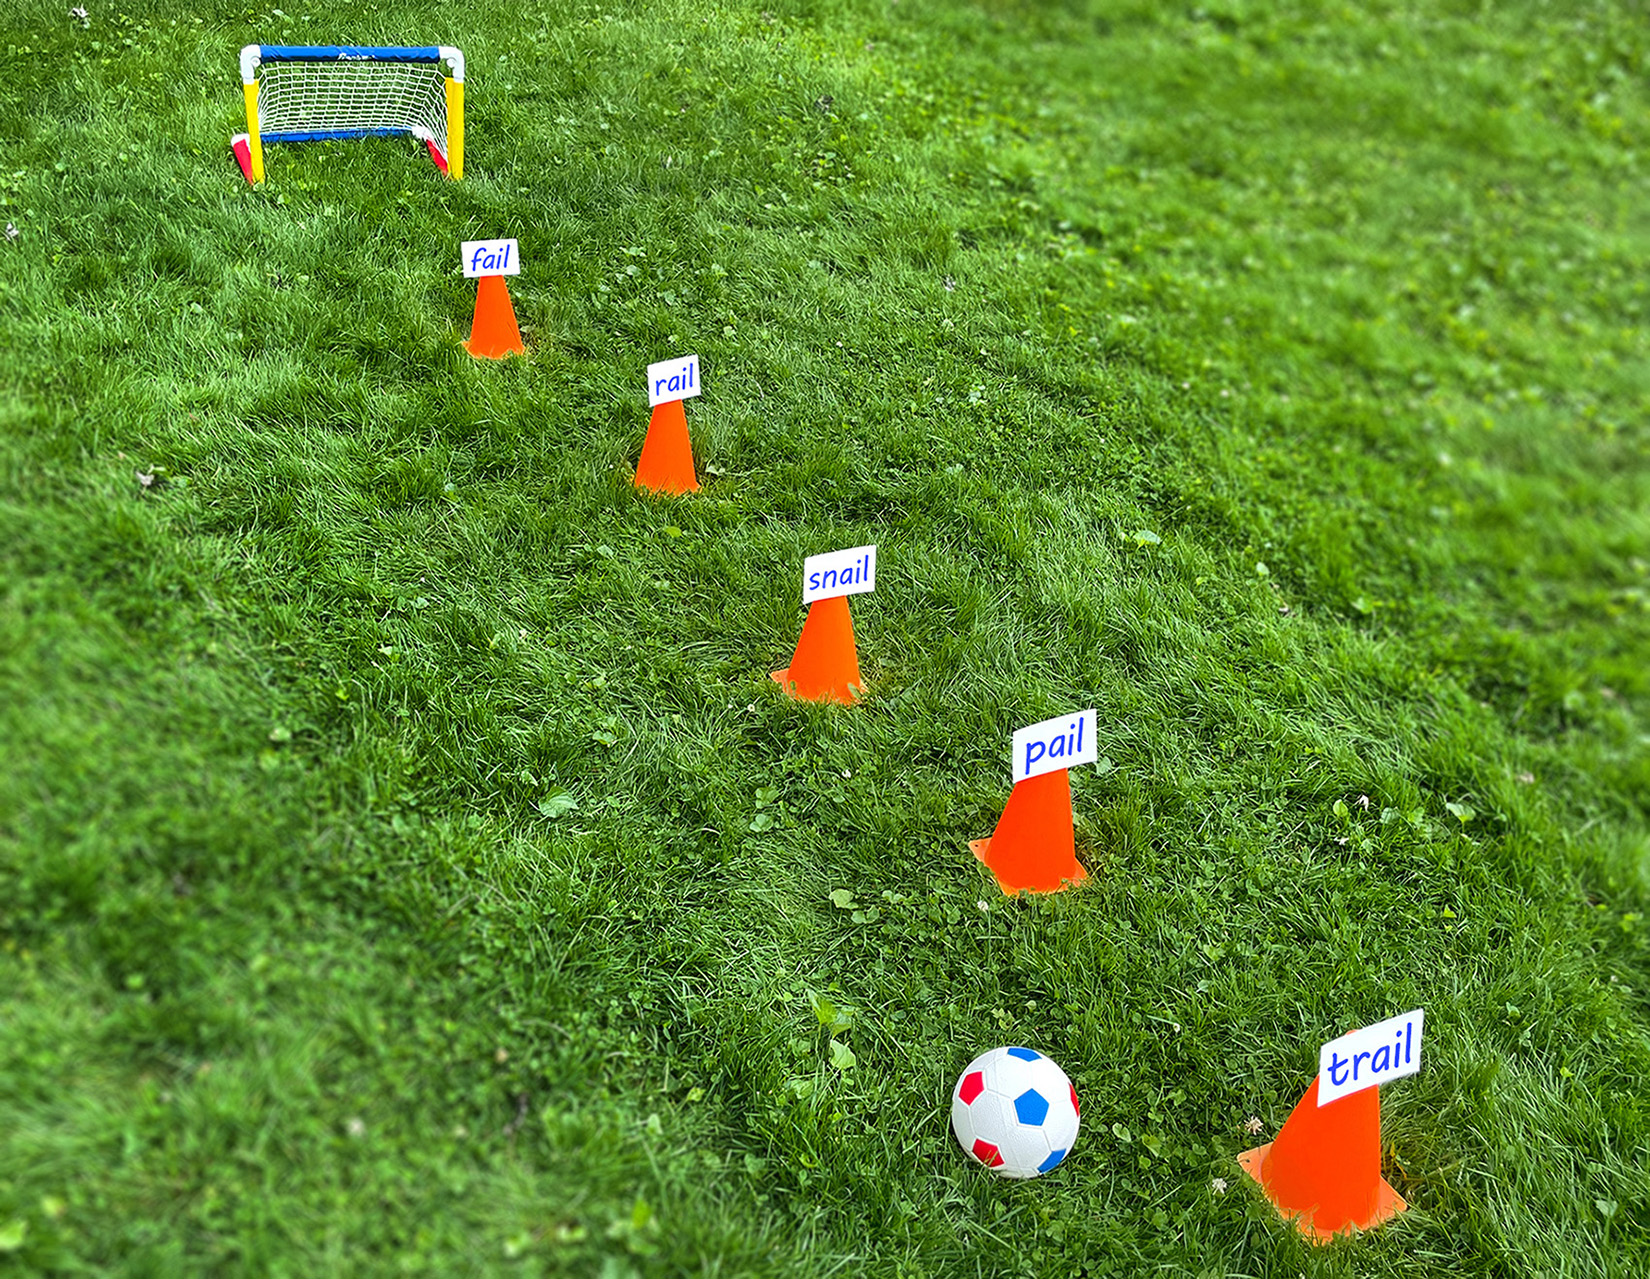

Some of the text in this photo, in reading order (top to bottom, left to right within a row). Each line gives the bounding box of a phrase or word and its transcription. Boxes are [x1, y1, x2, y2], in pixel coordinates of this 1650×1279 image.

[470, 243, 511, 272] fail
[655, 362, 694, 397] rail
[808, 554, 870, 591] snail
[1024, 716, 1085, 776] pail
[1326, 1021, 1413, 1087] trail
